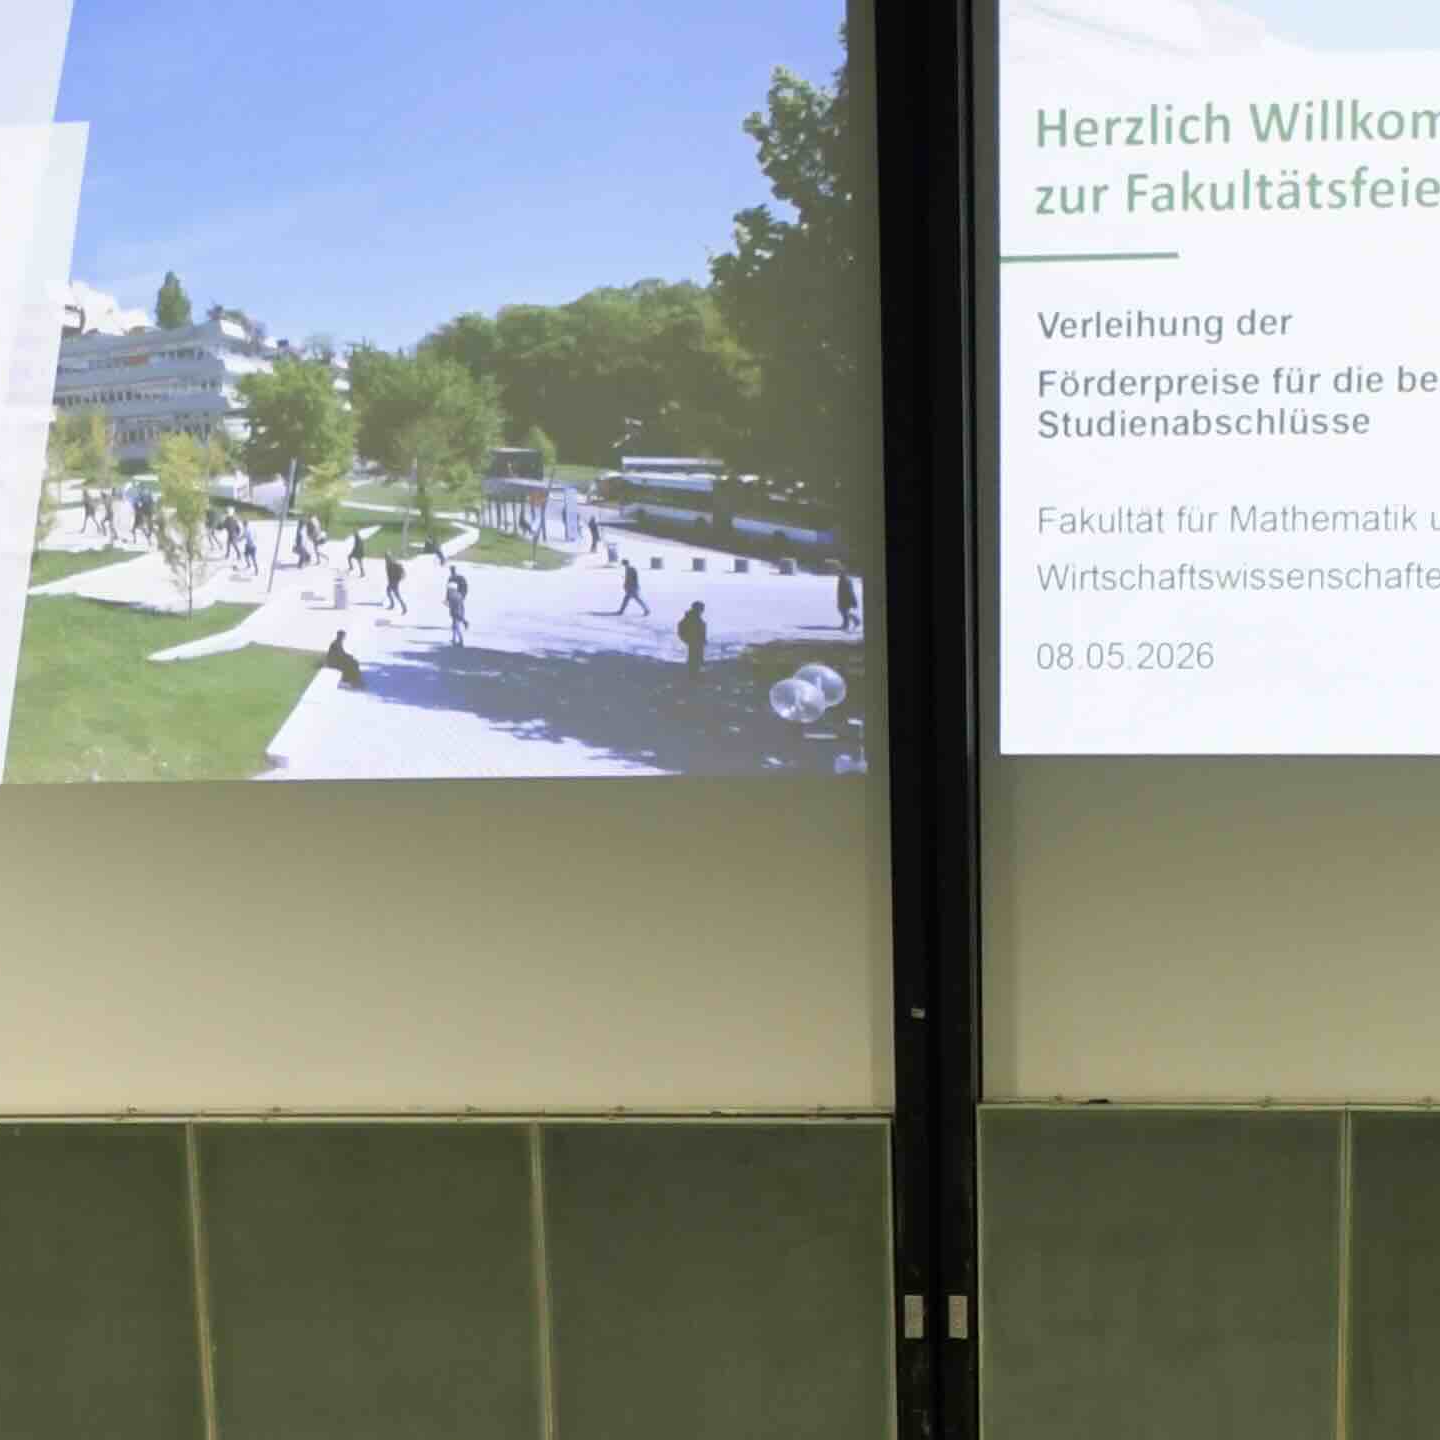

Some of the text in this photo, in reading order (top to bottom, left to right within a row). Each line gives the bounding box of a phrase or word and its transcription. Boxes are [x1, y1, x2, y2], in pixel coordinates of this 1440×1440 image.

[1037, 102, 1230, 148] Herzlich
[1036, 184, 1107, 215] zur
[1038, 309, 1292, 344] Verleihung der
[1039, 368, 1259, 403] Förderpreise
[1273, 367, 1321, 394] für
[1333, 366, 1383, 393] die
[1038, 408, 1369, 439] Studienabschlüsse
[1039, 506, 1164, 534] Fakultät
[1177, 506, 1218, 533] für
[1231, 505, 1417, 532] Mathematik
[1037, 642, 1214, 670] 08.05.2026
